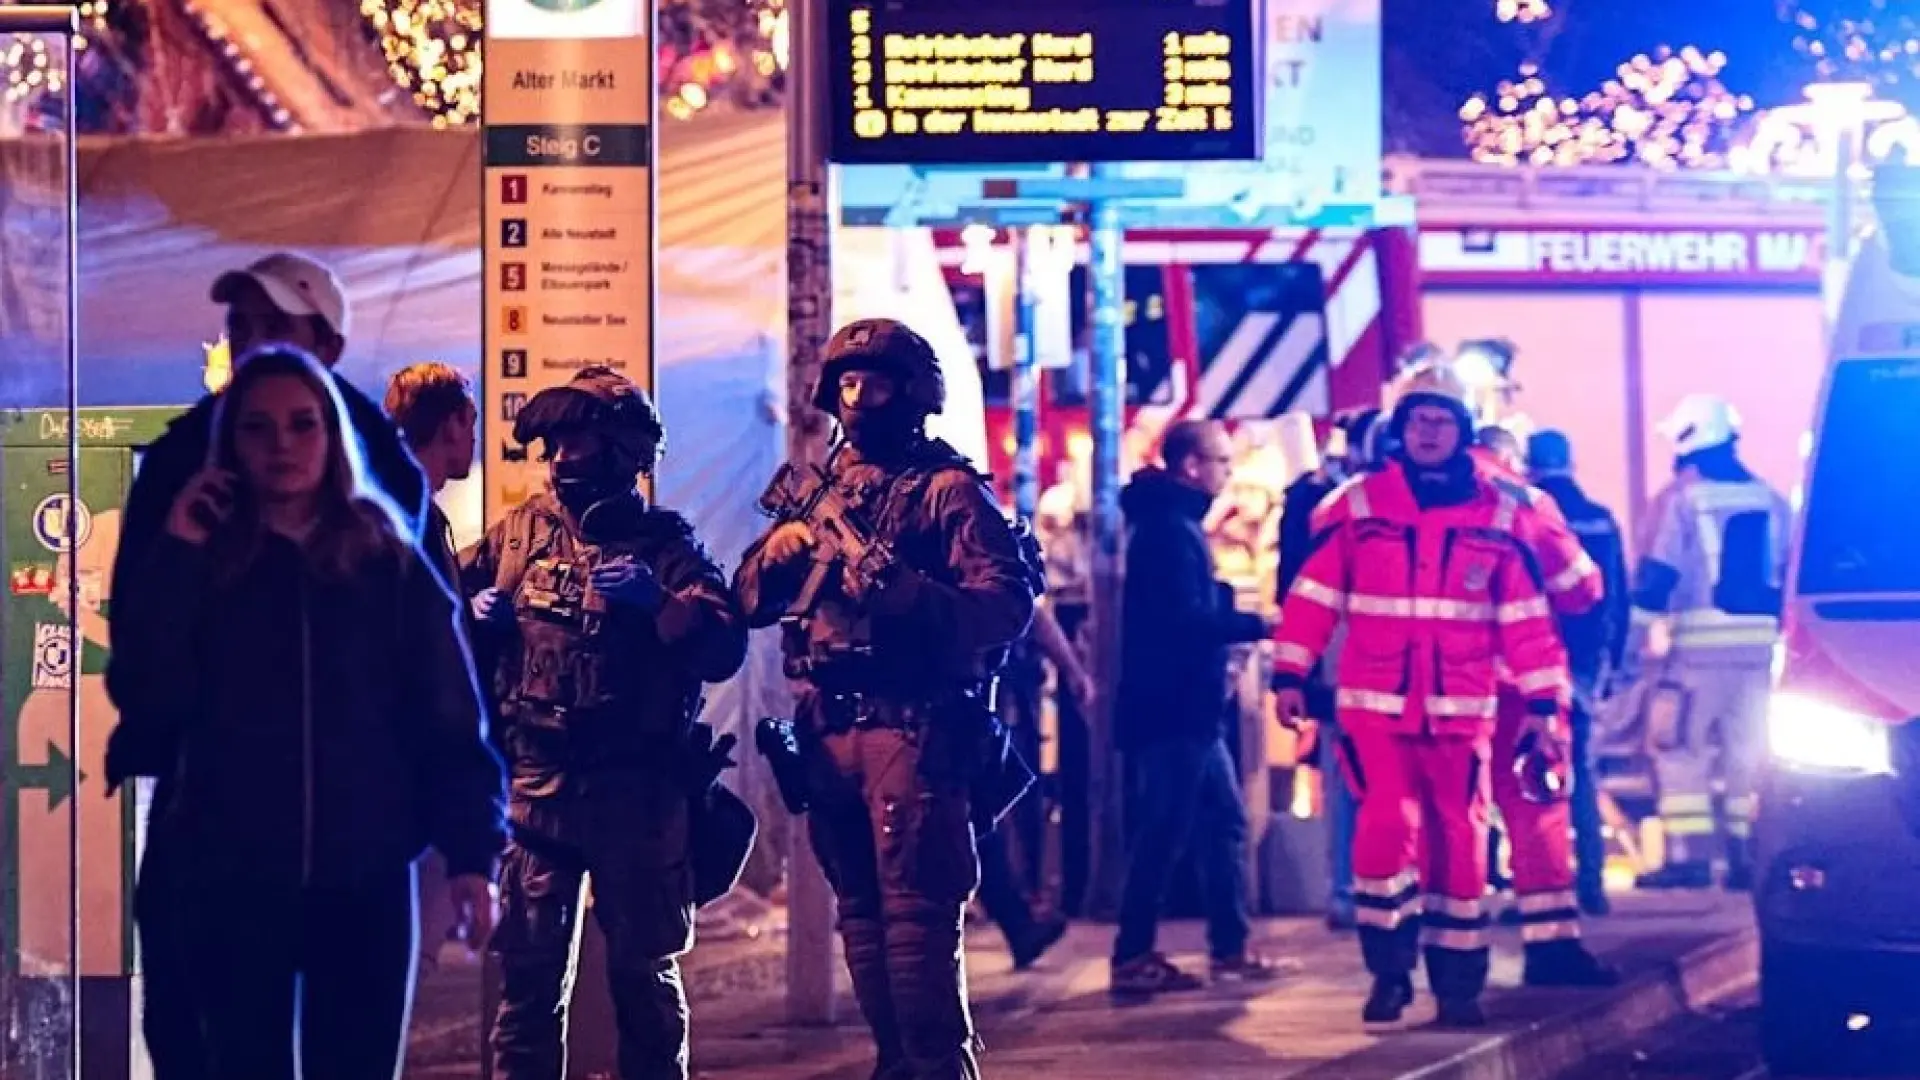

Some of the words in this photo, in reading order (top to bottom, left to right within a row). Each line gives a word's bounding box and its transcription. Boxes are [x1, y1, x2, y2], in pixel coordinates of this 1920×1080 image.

[512, 71, 555, 90] Alter
[561, 70, 615, 90] Markt
[526, 134, 578, 160] Steig
[583, 135, 600, 156] C
[509, 179, 518, 199] 1
[507, 222, 520, 244] 2
[1535, 232, 1747, 271] FEUERWEHR
[507, 266, 520, 288] 5
[509, 310, 519, 331] 8
[507, 353, 520, 375] 9
